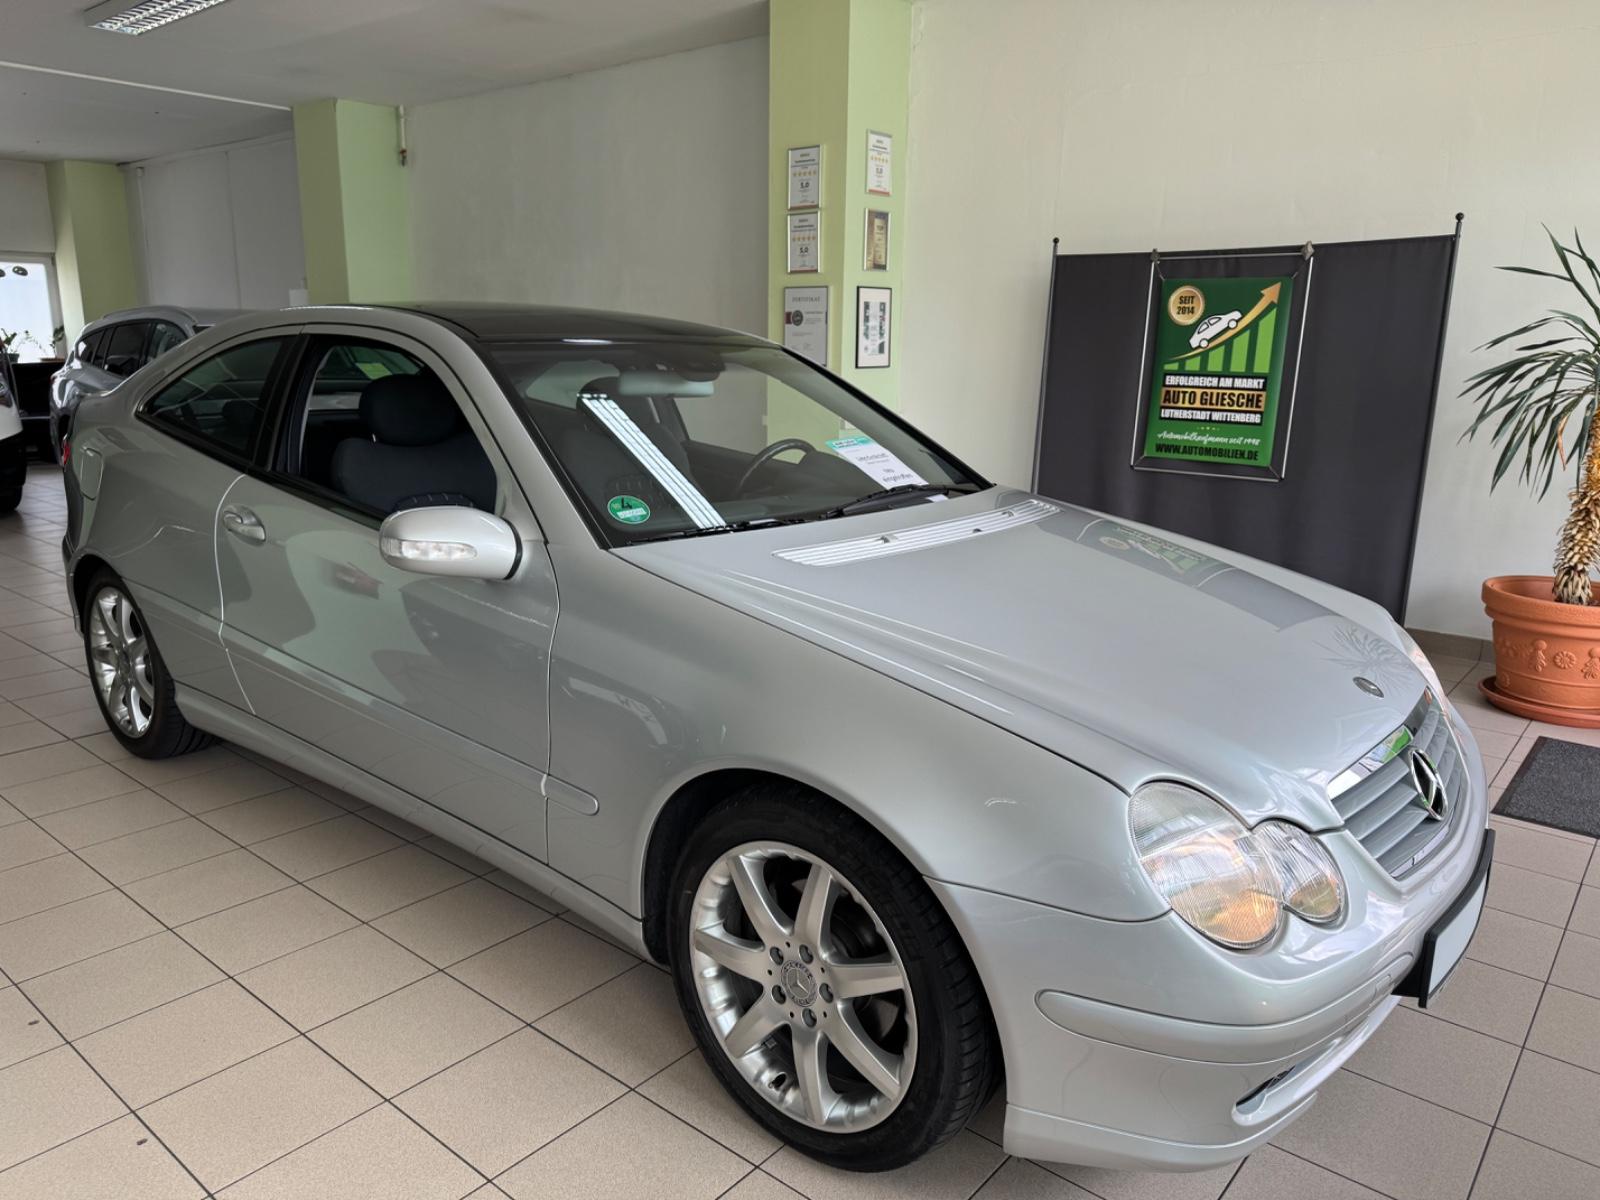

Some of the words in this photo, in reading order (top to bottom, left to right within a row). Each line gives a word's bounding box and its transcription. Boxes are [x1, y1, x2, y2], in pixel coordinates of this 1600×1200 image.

[1179, 295, 1195, 305] SEIT
[1176, 306, 1195, 315] 2014
[1165, 375, 1218, 387] ERFOLGREICH
[1219, 377, 1233, 388] AM
[1234, 378, 1265, 389] MARKT
[1162, 390, 1197, 405] AUTO
[1200, 391, 1263, 409] GLIESCHE
[1161, 409, 1211, 421] LUTHERSTADT
[1211, 411, 1261, 423] WITTENBERG
[1229, 435, 1244, 445] seit
[1155, 443, 1259, 461] WWW.AUTOMOBILIEN.DE
